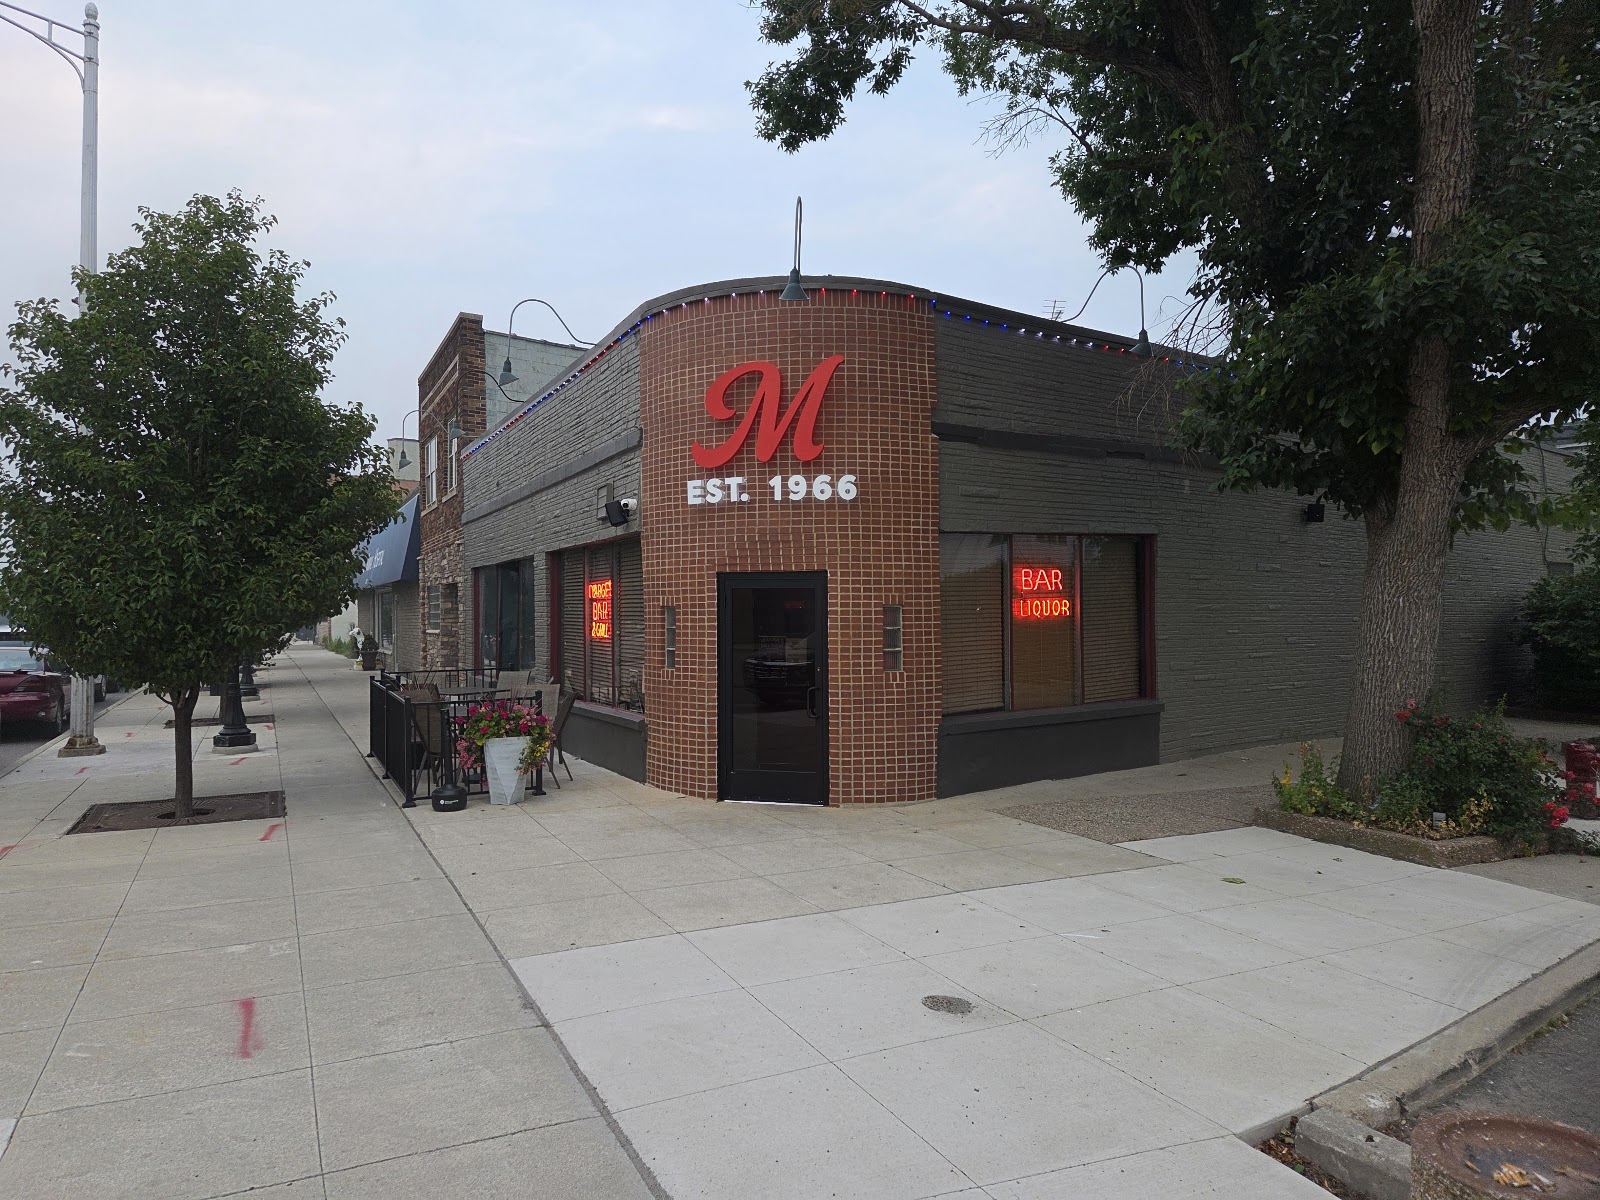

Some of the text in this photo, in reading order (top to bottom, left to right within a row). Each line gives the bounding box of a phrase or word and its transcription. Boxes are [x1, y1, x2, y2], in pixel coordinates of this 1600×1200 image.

[692, 354, 844, 468] M
[687, 474, 858, 505] EST. 1966
[1021, 568, 1063, 591] BAR
[592, 601, 608, 621] BAR
[1020, 599, 1070, 618] LIQUOR
